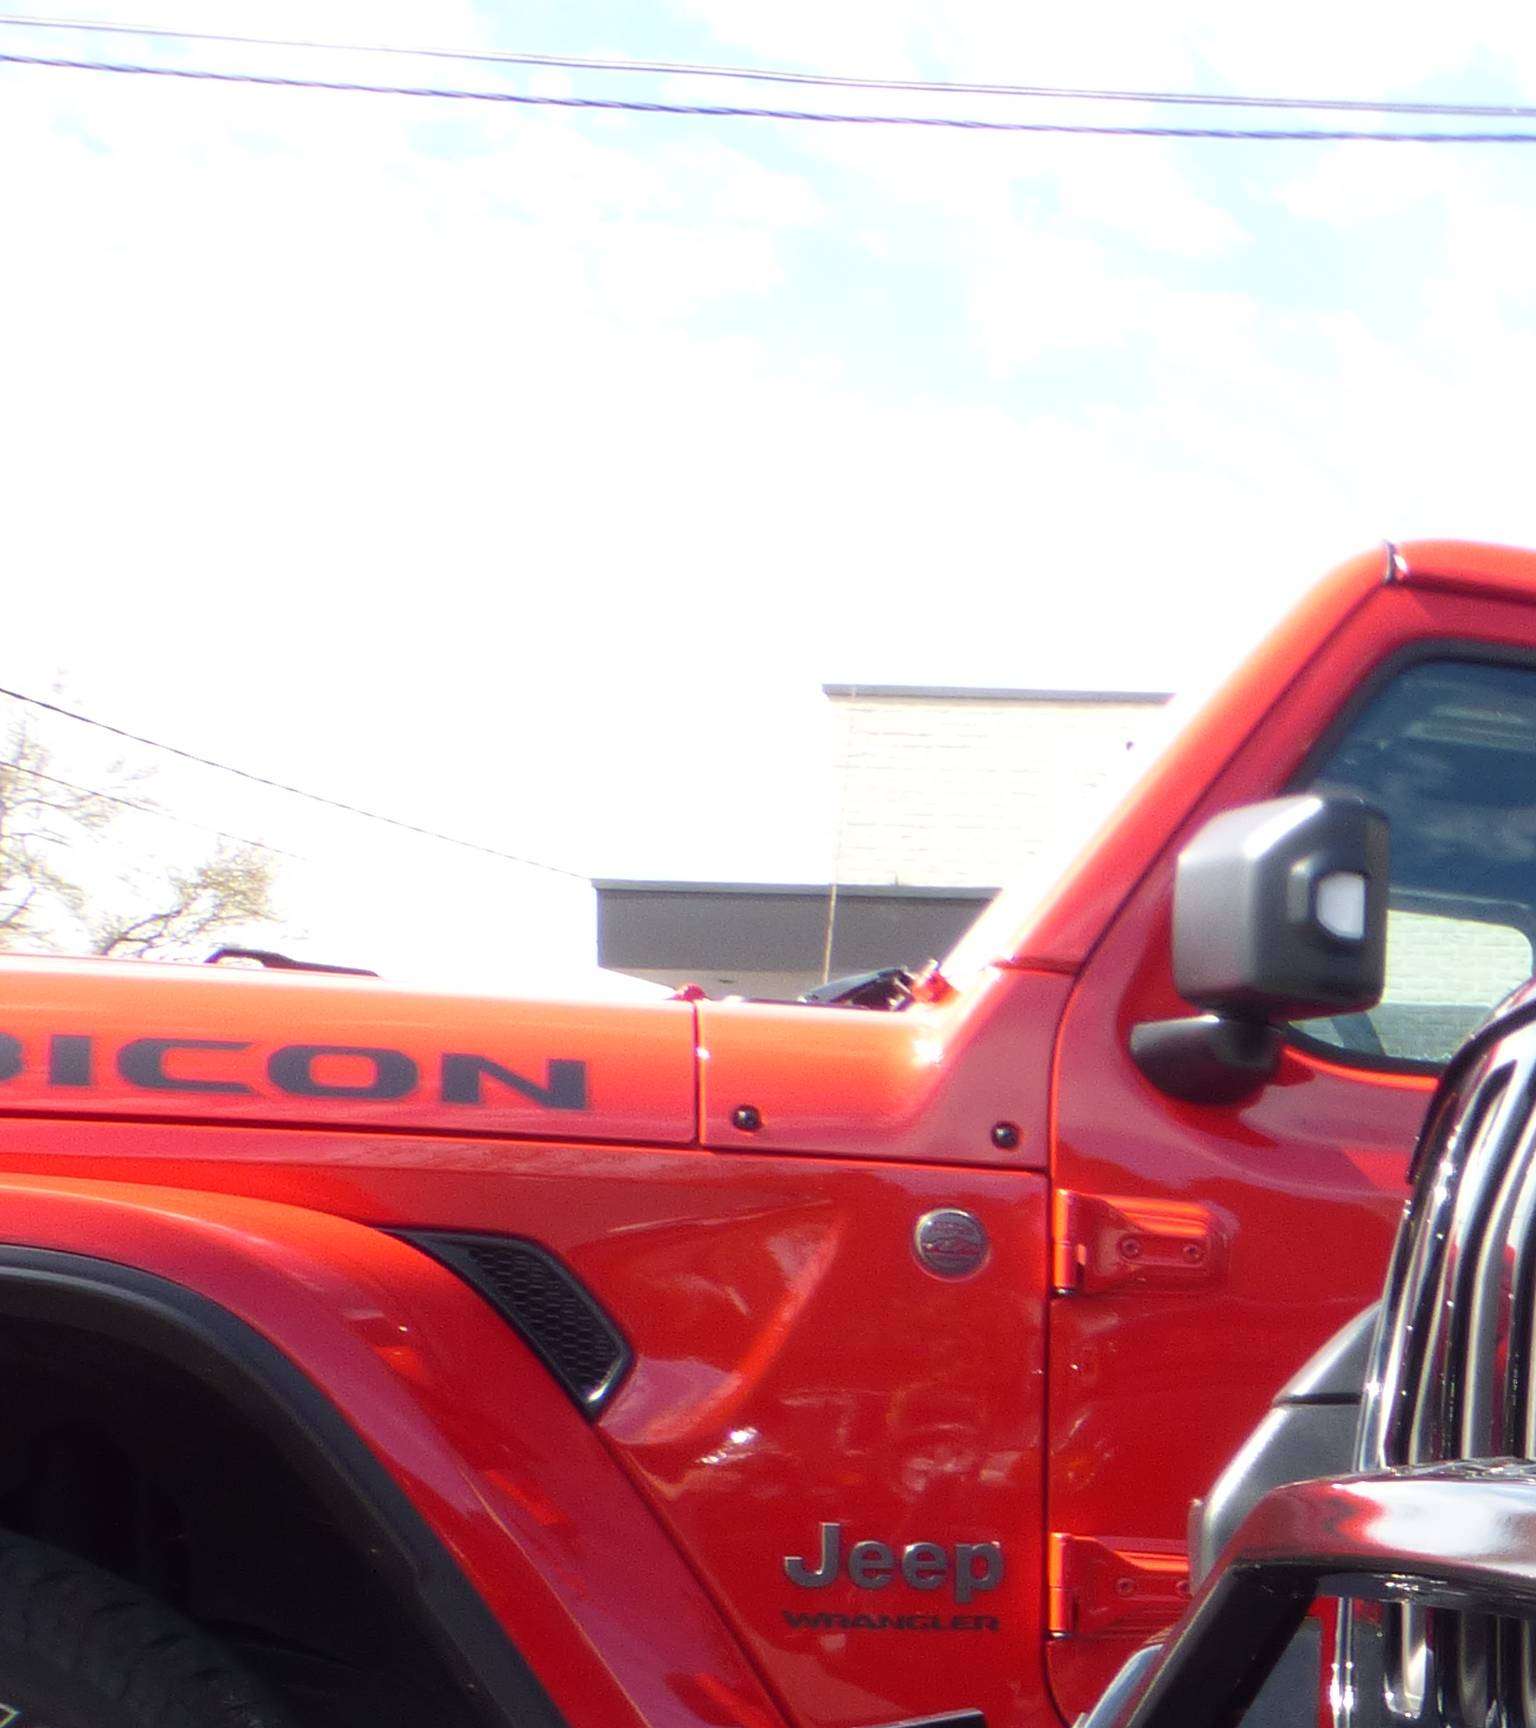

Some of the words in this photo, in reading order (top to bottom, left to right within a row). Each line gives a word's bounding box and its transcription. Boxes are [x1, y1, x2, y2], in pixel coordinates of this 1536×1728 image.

[0, 1031, 590, 1111] ICON
[784, 1521, 1004, 1604] Jeep
[780, 1609, 1000, 1633] WRANGLER
